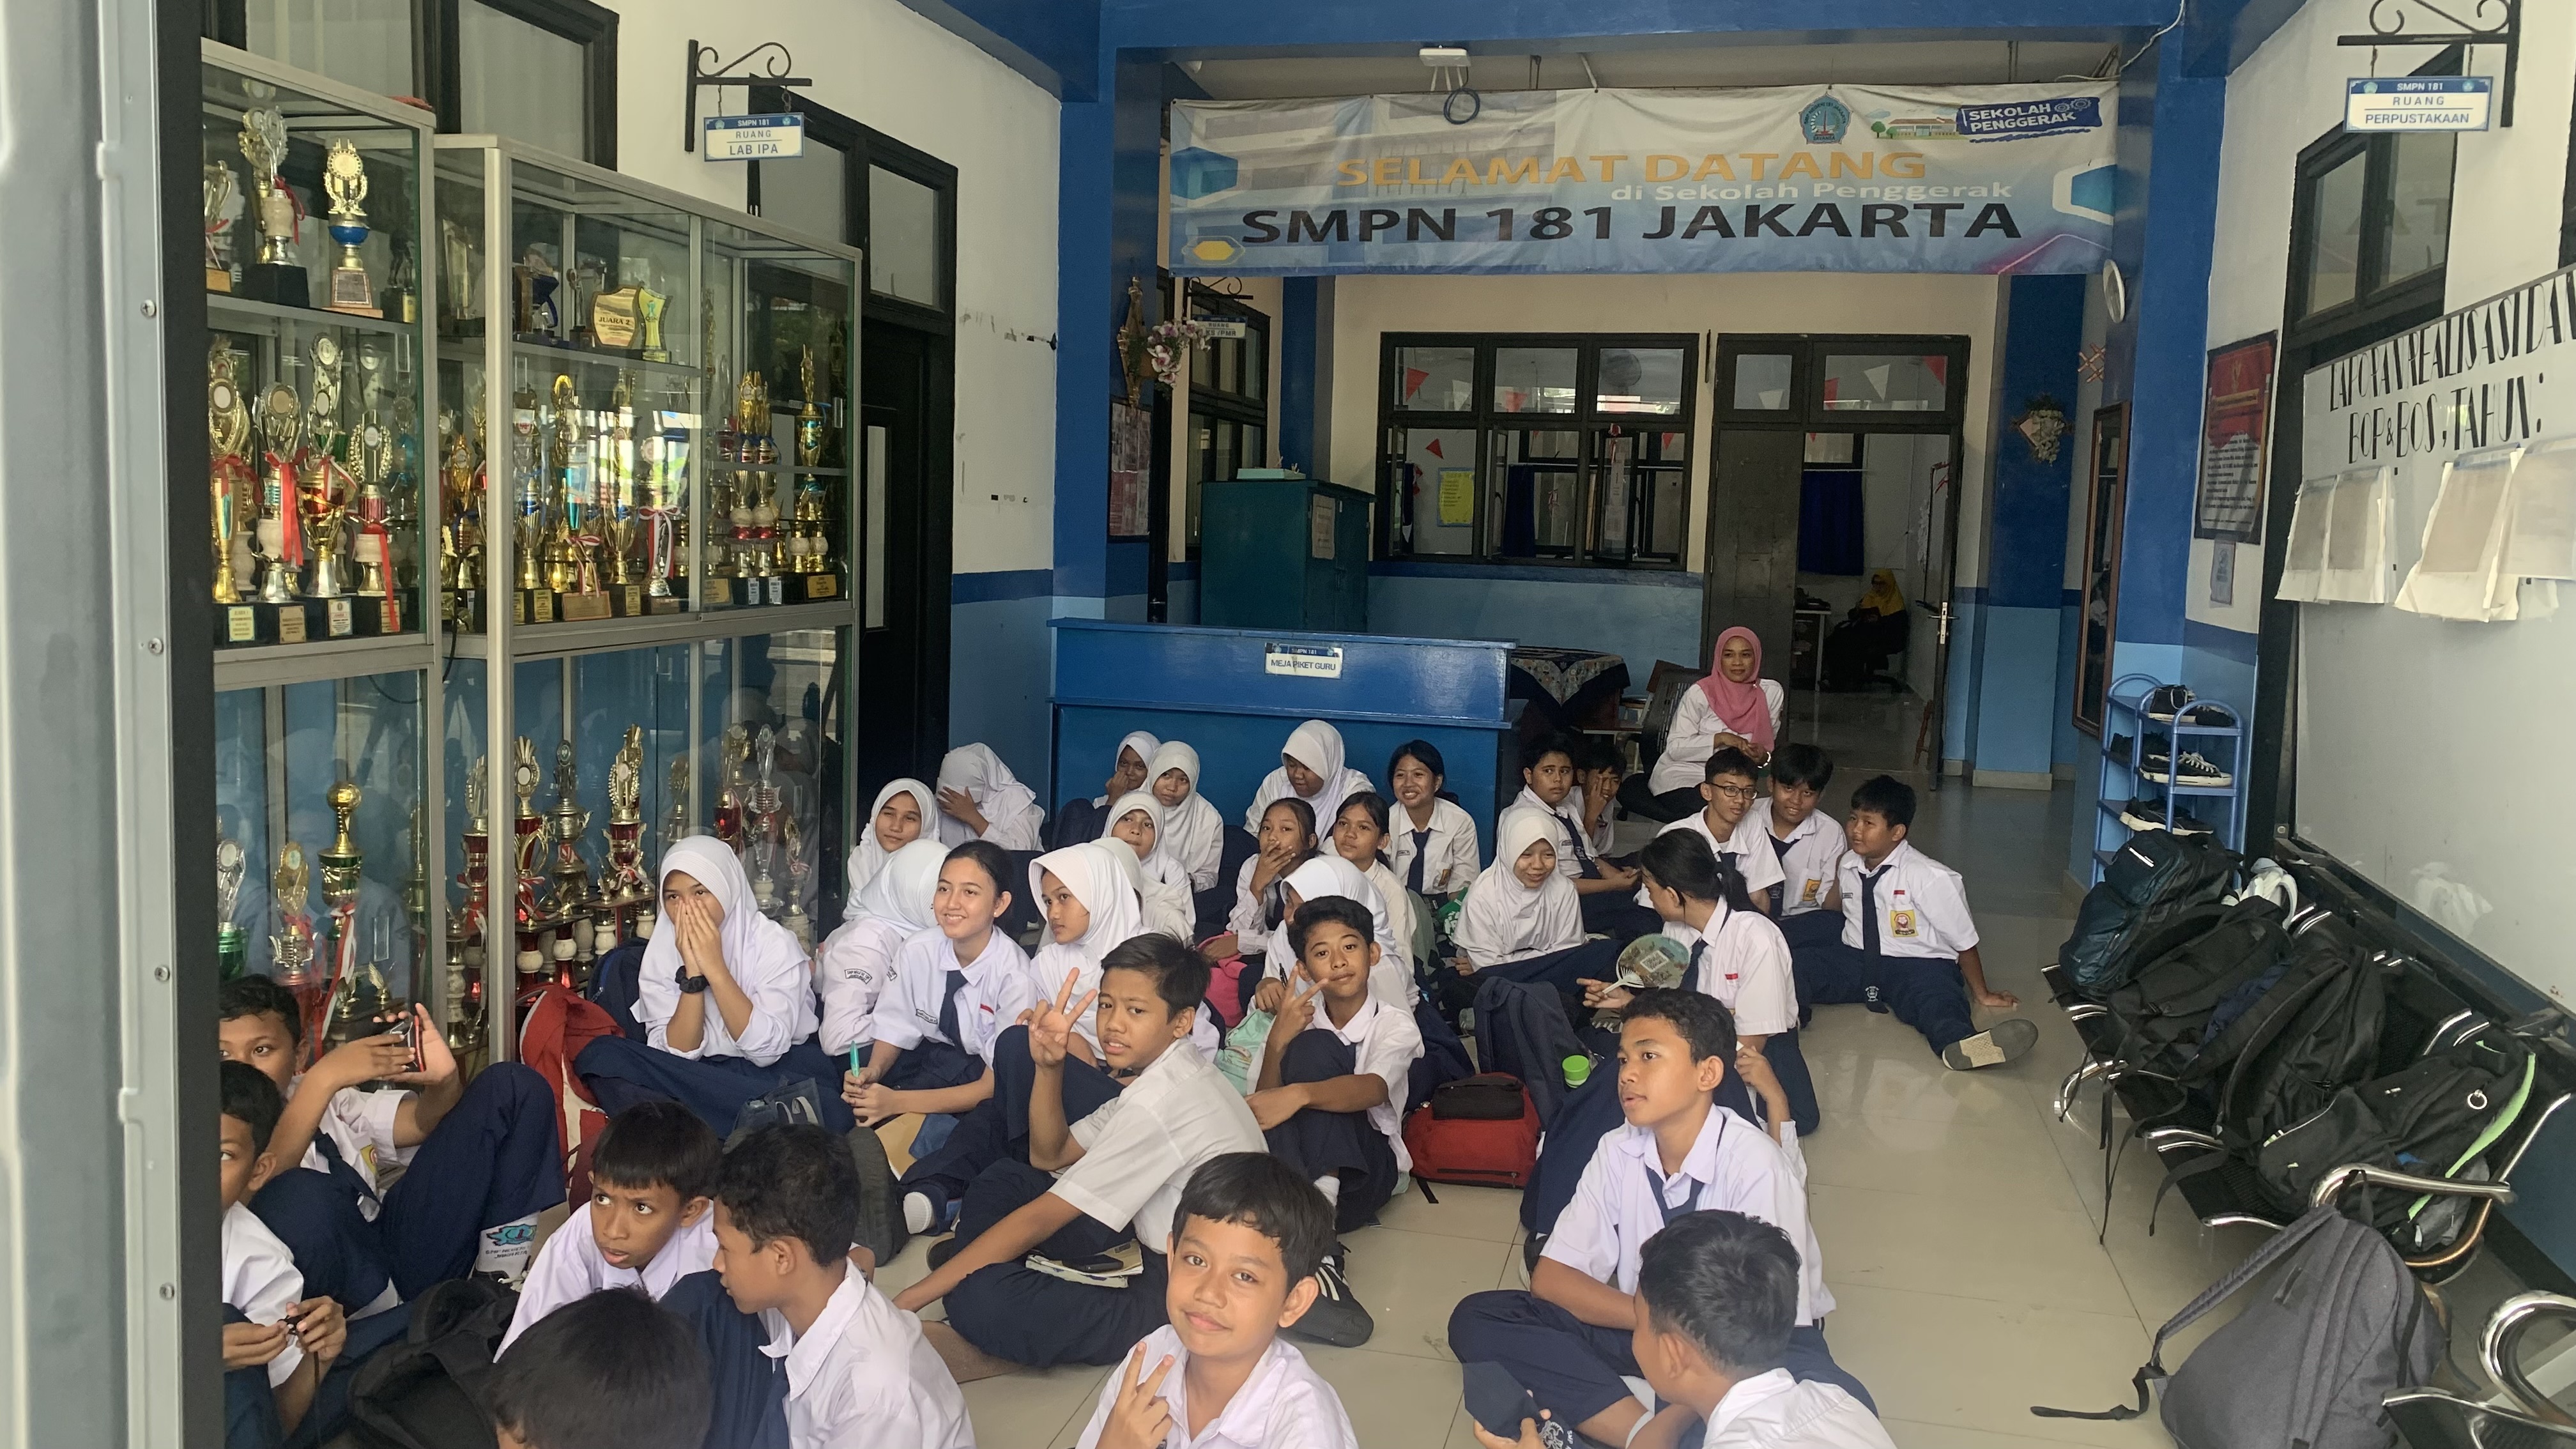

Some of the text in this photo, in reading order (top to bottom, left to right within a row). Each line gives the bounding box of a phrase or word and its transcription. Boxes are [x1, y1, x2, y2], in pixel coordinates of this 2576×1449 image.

[2397, 82, 2425, 91] SMPN
[2393, 96, 2444, 105] RUANG
[1969, 103, 2051, 121] SEKOLAH
[1970, 112, 2076, 132] PENGGERAK
[2366, 113, 2469, 123] PERPUSTAKAAN
[736, 130, 771, 139] RUANG
[730, 144, 778, 155] LAB IPA
[1337, 151, 1926, 187] SELAMAT DATANG
[1611, 181, 2012, 201] di Sekolah Penggerak
[1242, 203, 2022, 243] SMPN 181 JAKARTA
[1292, 661, 1314, 669] PIKET
